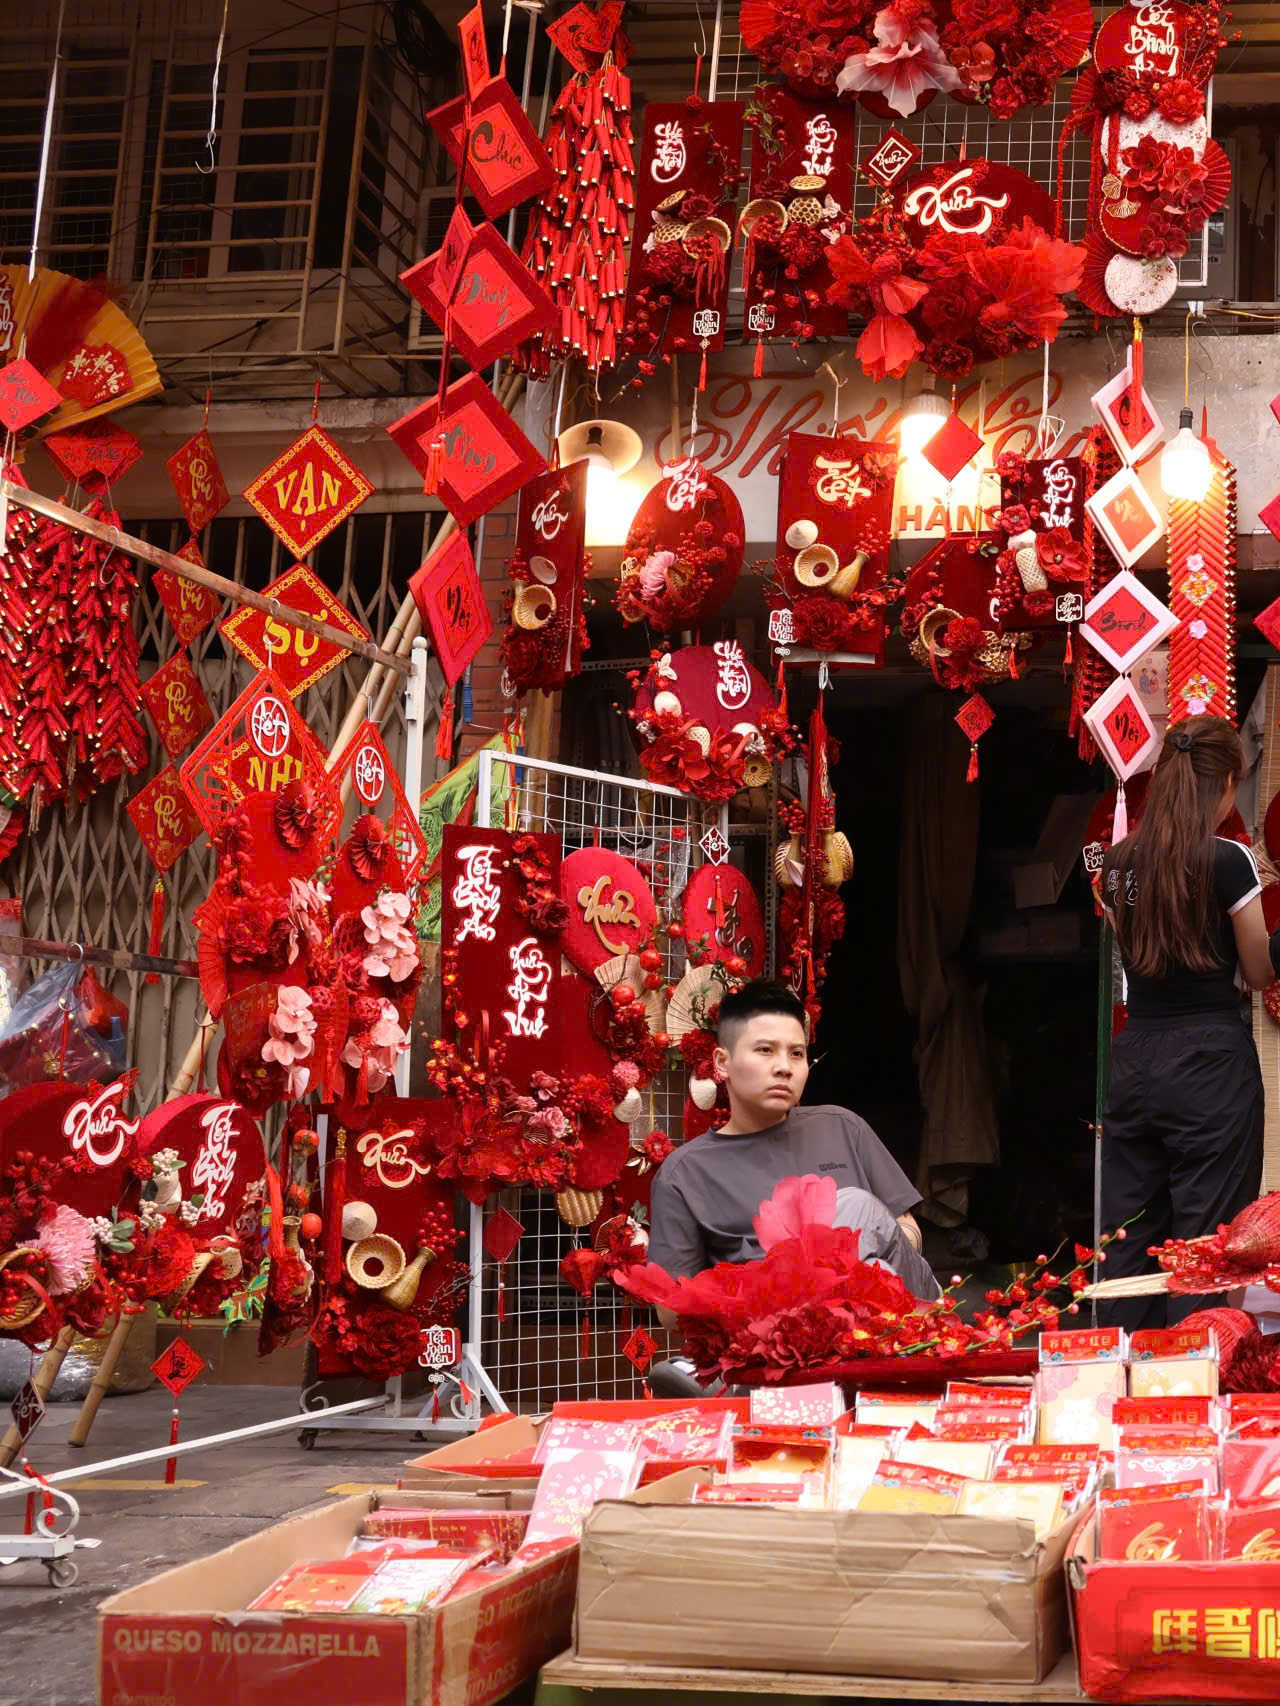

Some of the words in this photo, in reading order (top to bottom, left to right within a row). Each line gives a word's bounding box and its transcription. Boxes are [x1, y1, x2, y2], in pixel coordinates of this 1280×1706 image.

[904, 168, 1007, 234] Xuân
[271, 462, 341, 532] VẠN
[662, 457, 712, 511] Tết
[814, 456, 872, 507] Tết
[531, 490, 569, 540] Xuân
[247, 753, 303, 793] NH
[457, 845, 504, 890] Tết
[578, 875, 640, 956] Xuân
[509, 938, 551, 985] Xuân
[62, 1082, 139, 1166] Xuân
[201, 1103, 240, 1155] Tết
[357, 1129, 429, 1189] Xuân
[425, 1331, 446, 1346] Tết
[114, 1628, 203, 1654] QUESO
[210, 1631, 381, 1658] MOZZARELLA
